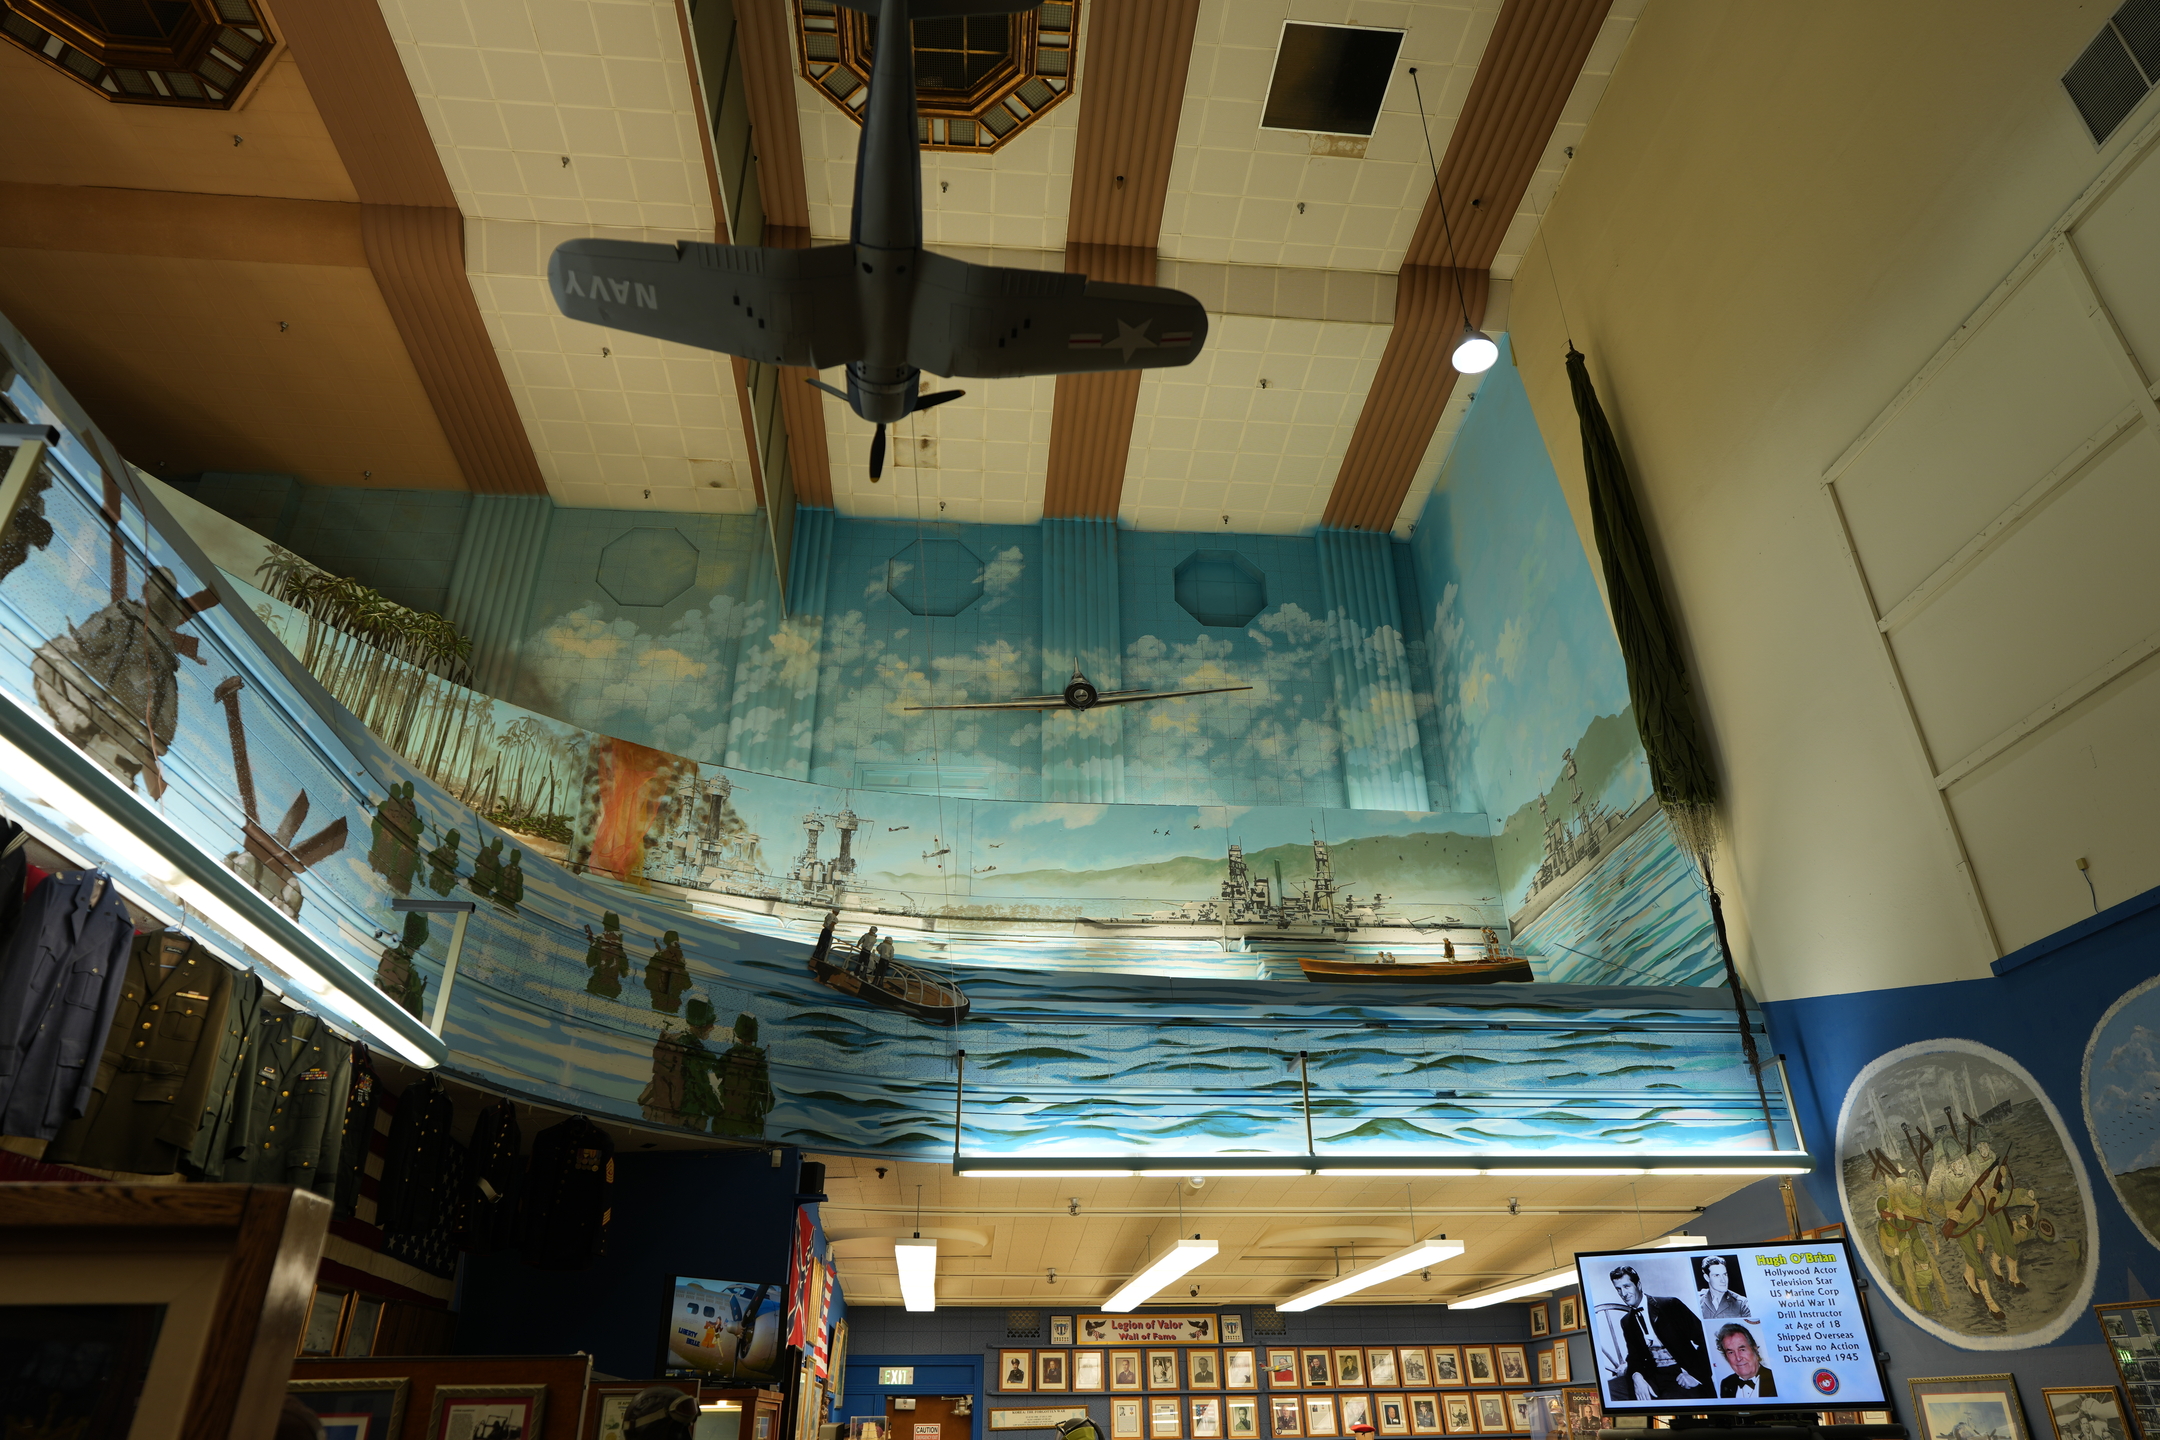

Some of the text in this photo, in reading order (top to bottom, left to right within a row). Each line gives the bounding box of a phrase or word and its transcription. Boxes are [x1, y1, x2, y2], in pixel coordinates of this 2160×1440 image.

[565, 269, 658, 310] NAVY
[1755, 1252, 1837, 1267] Hugh O'Brian
[1764, 1266, 1837, 1277] Hollywood Actor
[1770, 1277, 1833, 1287] Television Star
[1769, 1287, 1840, 1298] US Marine Corp
[1778, 1298, 1836, 1308] World War II
[1777, 1310, 1843, 1319] Drill Instructor
[1111, 1320, 1183, 1332] Legion of Valor
[1784, 1320, 1841, 1330] at Age of 18
[678, 1327, 698, 1338] LIBERTY
[1777, 1331, 1854, 1342] Shipped Overseas
[1777, 1344, 1793, 1352] but
[1795, 1343, 1812, 1352] Saw
[1830, 1342, 1860, 1351] Action
[1783, 1352, 1859, 1364] Discharged 1945
[884, 1370, 908, 1385] EXIT
